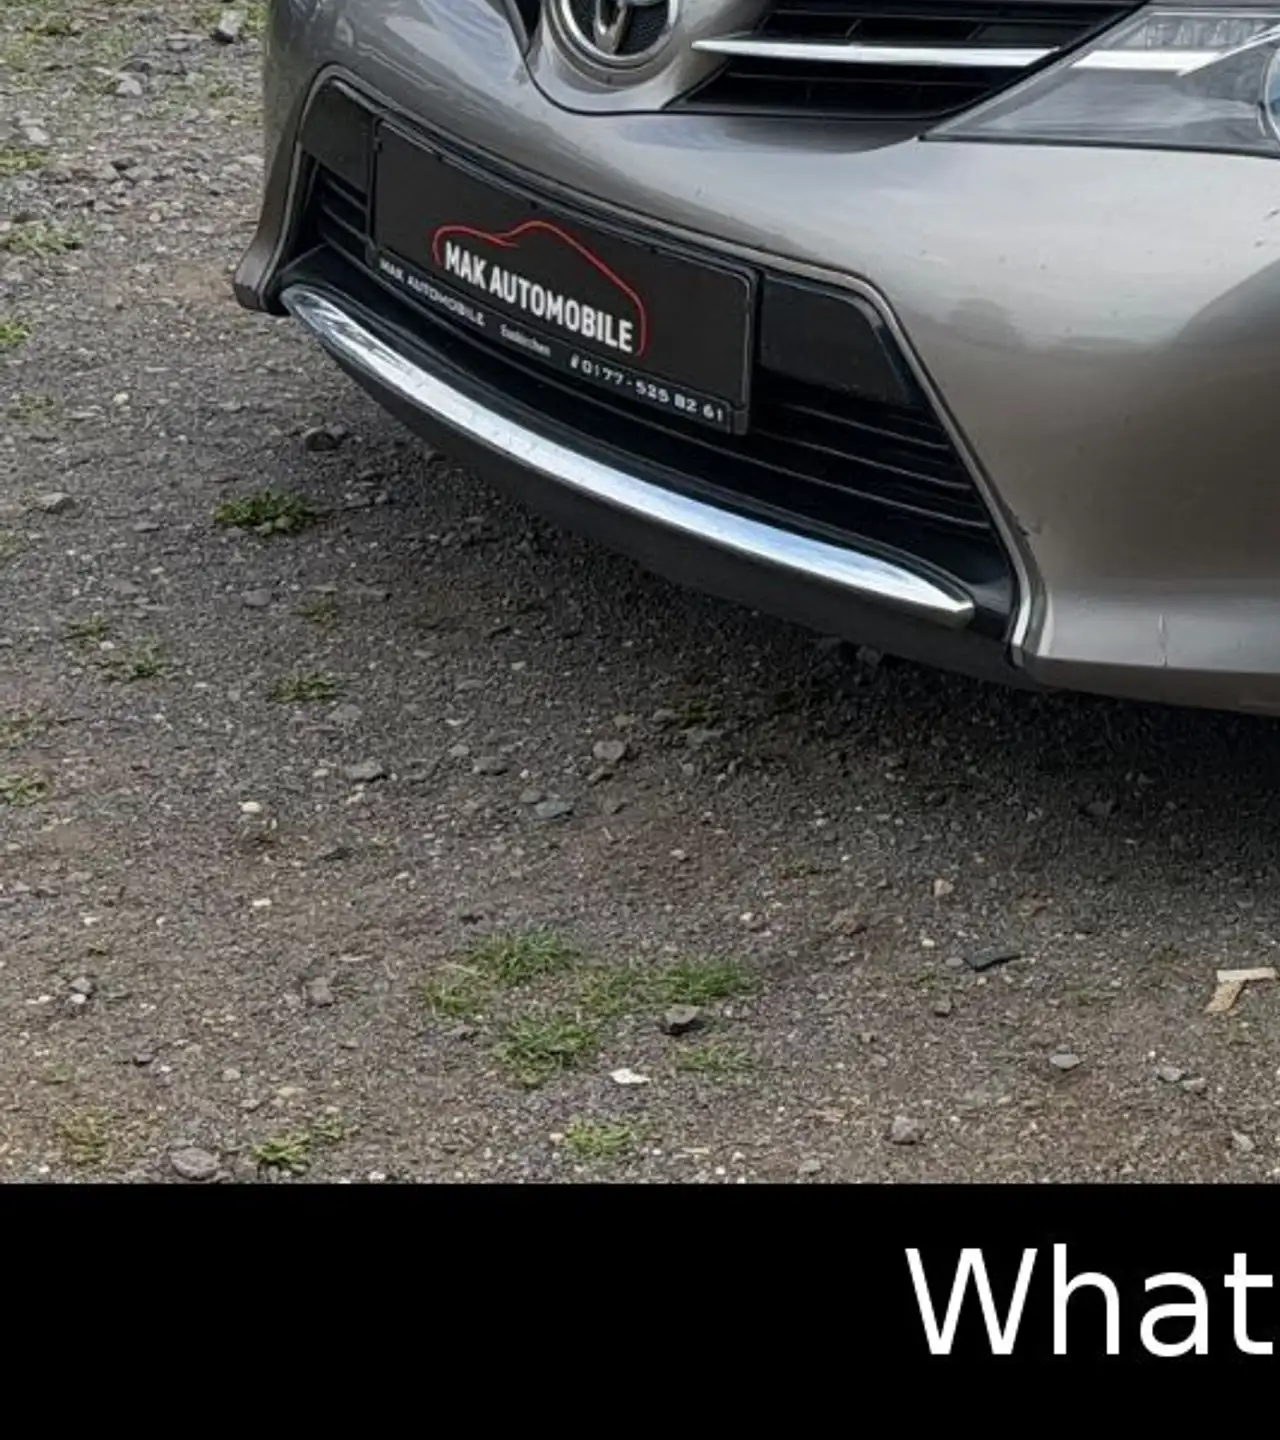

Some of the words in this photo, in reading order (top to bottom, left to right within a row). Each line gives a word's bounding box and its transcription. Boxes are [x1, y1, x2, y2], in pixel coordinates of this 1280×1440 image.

[407, 274, 486, 328] AUTOMOBILE
[444, 241, 487, 290] MAK
[489, 266, 633, 354] AUTOMOBILE
